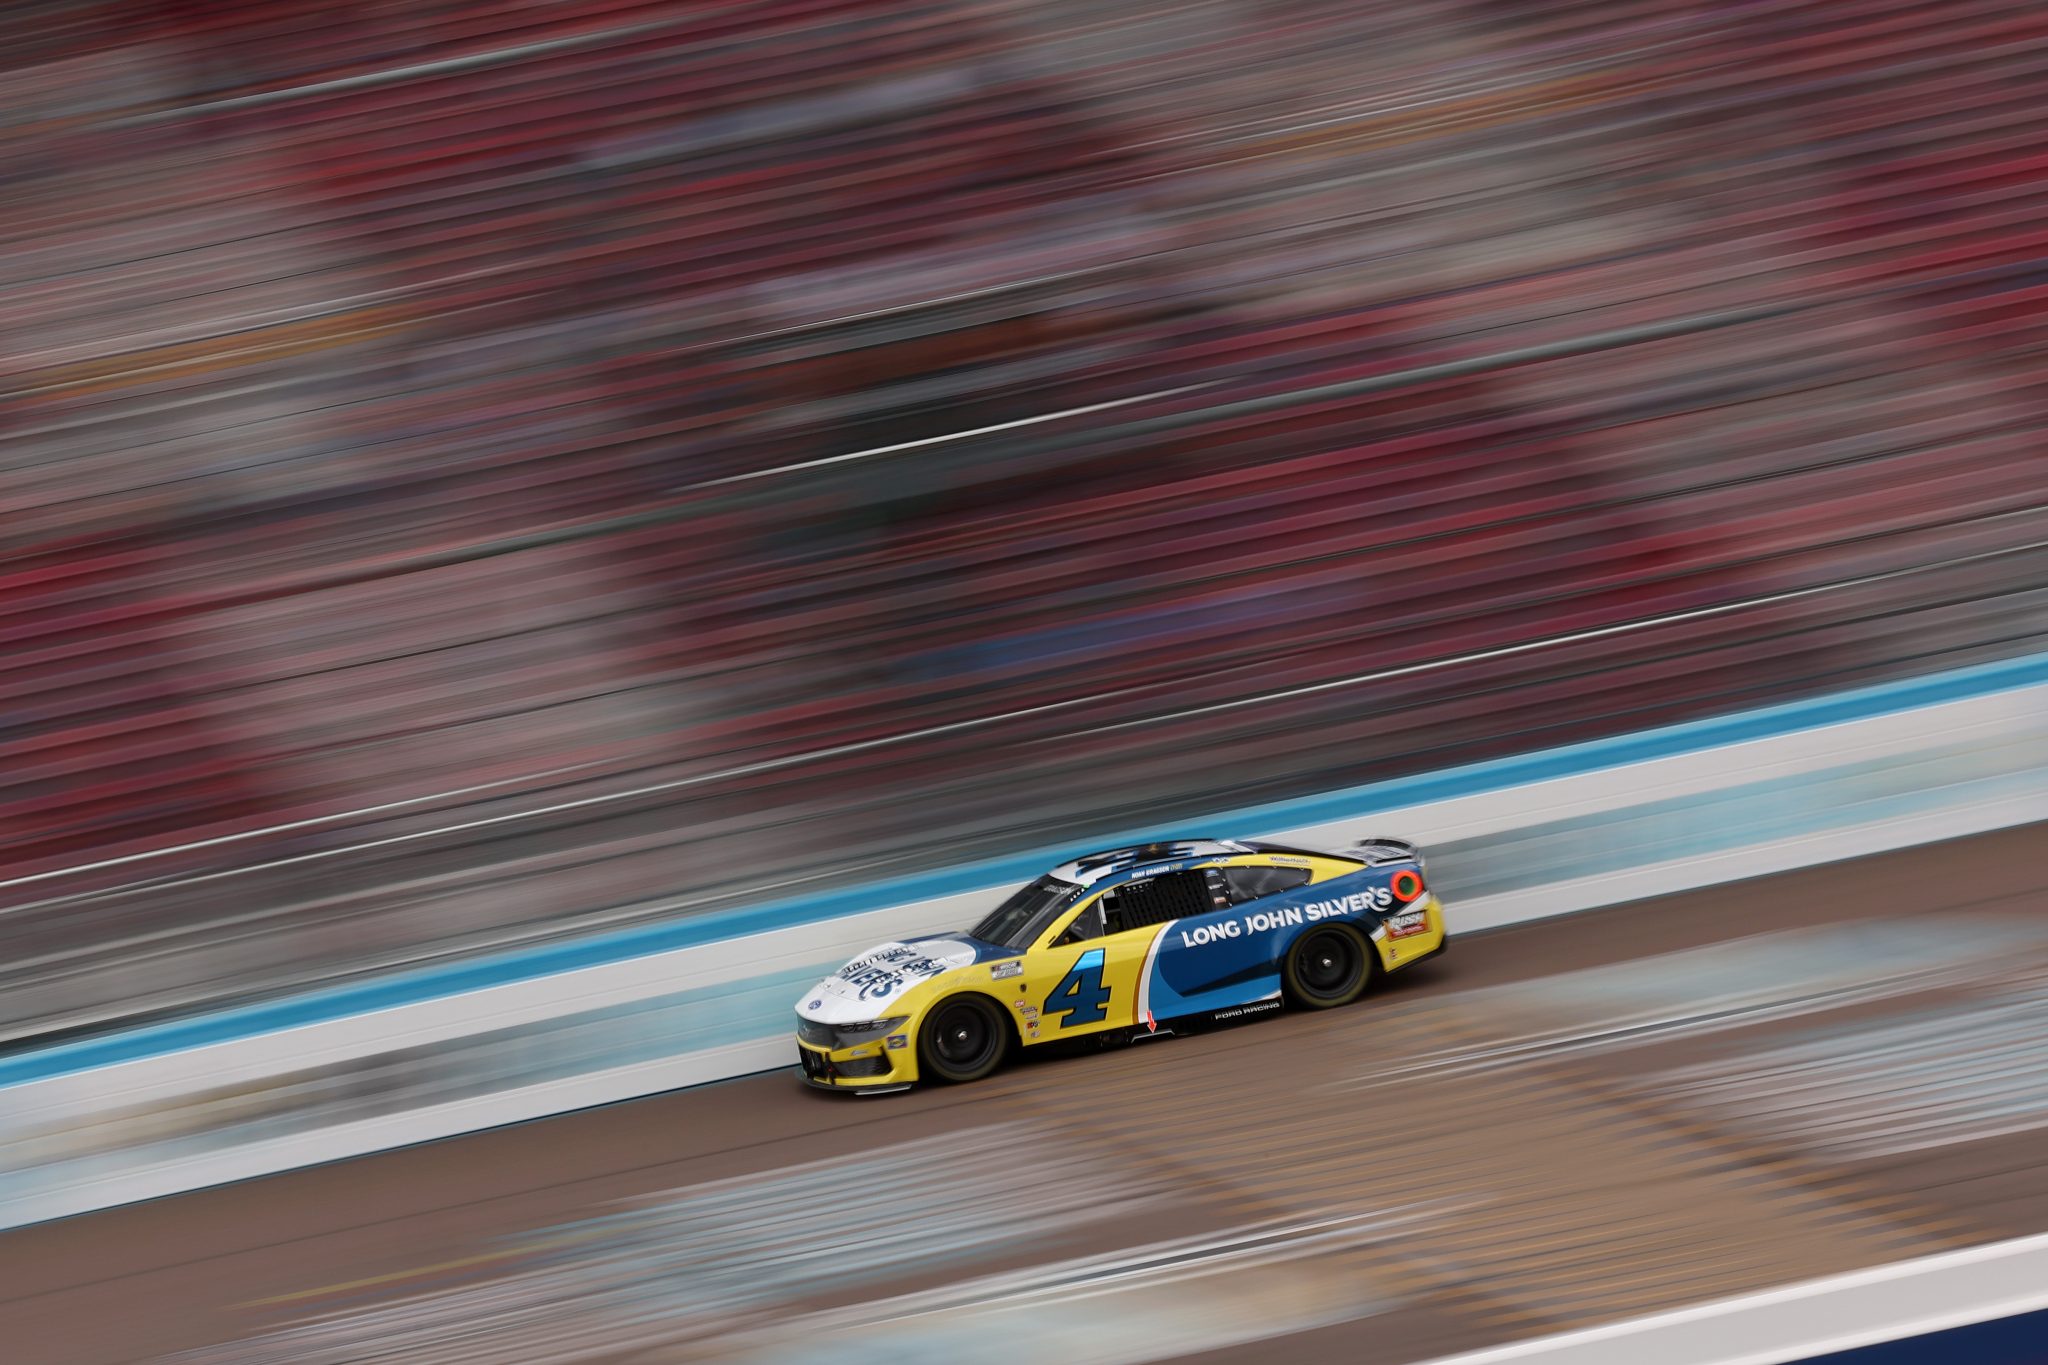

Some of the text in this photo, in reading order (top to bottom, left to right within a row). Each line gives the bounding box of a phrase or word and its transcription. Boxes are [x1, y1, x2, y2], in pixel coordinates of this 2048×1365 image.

[1181, 886, 1393, 948] LONG JOHN SILVER'S
[1042, 947, 1112, 1029] 4
[1214, 1009, 1243, 1020] FORD
